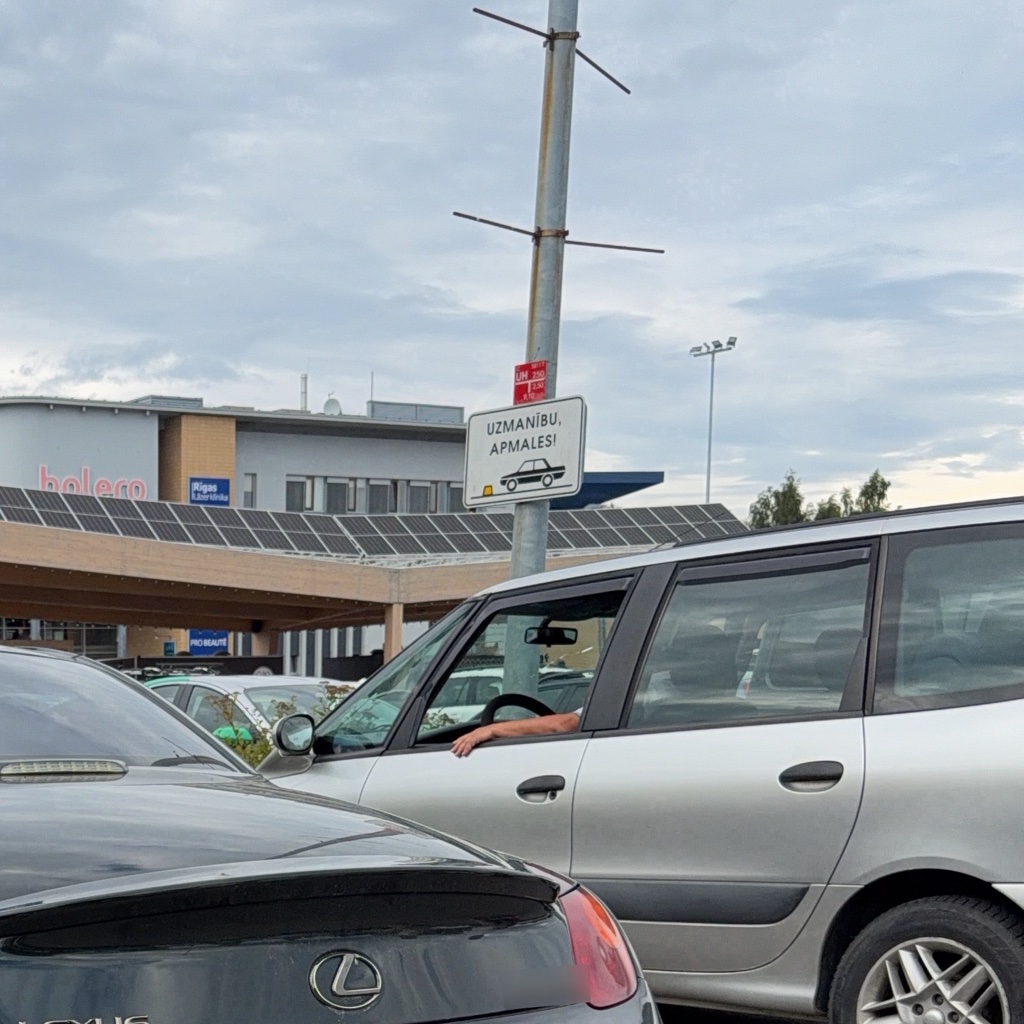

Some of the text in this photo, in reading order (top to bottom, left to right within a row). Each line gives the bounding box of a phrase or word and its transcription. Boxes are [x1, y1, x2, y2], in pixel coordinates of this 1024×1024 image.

[516, 371, 528, 382] UH
[487, 412, 561, 435] UZMANĪBU,
[489, 434, 556, 456] APMALES!
[39, 465, 147, 500] bolero
[190, 639, 202, 647] PRO
